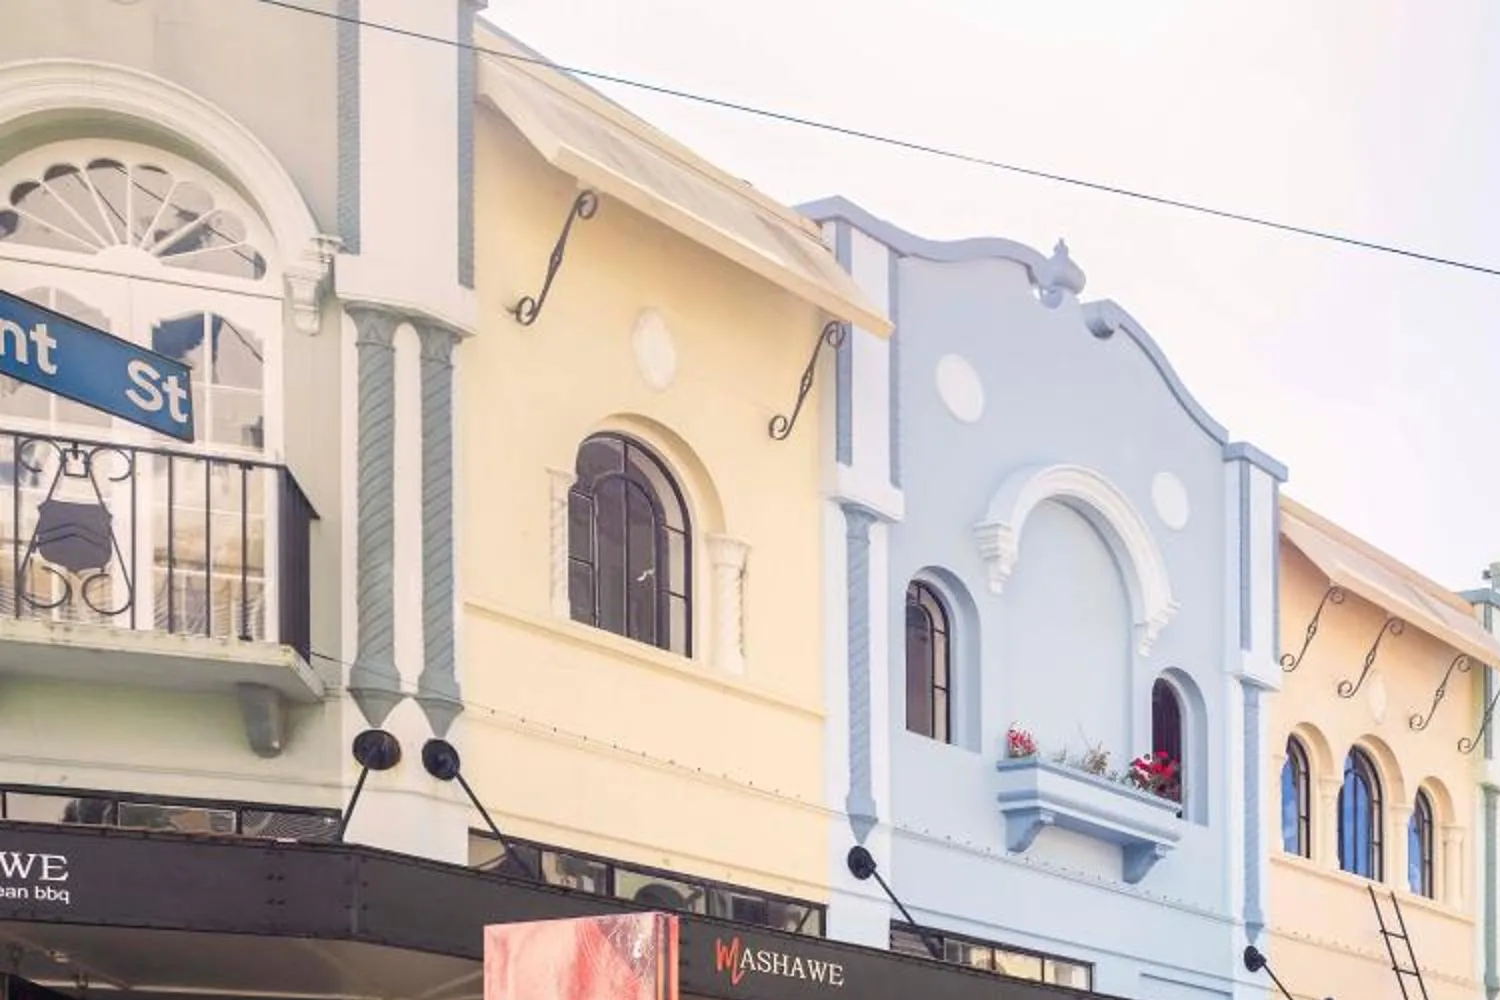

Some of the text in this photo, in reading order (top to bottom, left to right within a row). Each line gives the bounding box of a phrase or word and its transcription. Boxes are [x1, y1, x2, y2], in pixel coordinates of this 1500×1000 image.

[125, 359, 188, 423] St
[0, 851, 69, 881] WE
[35, 886, 70, 904] bbq
[715, 936, 844, 986] MASHAWE
